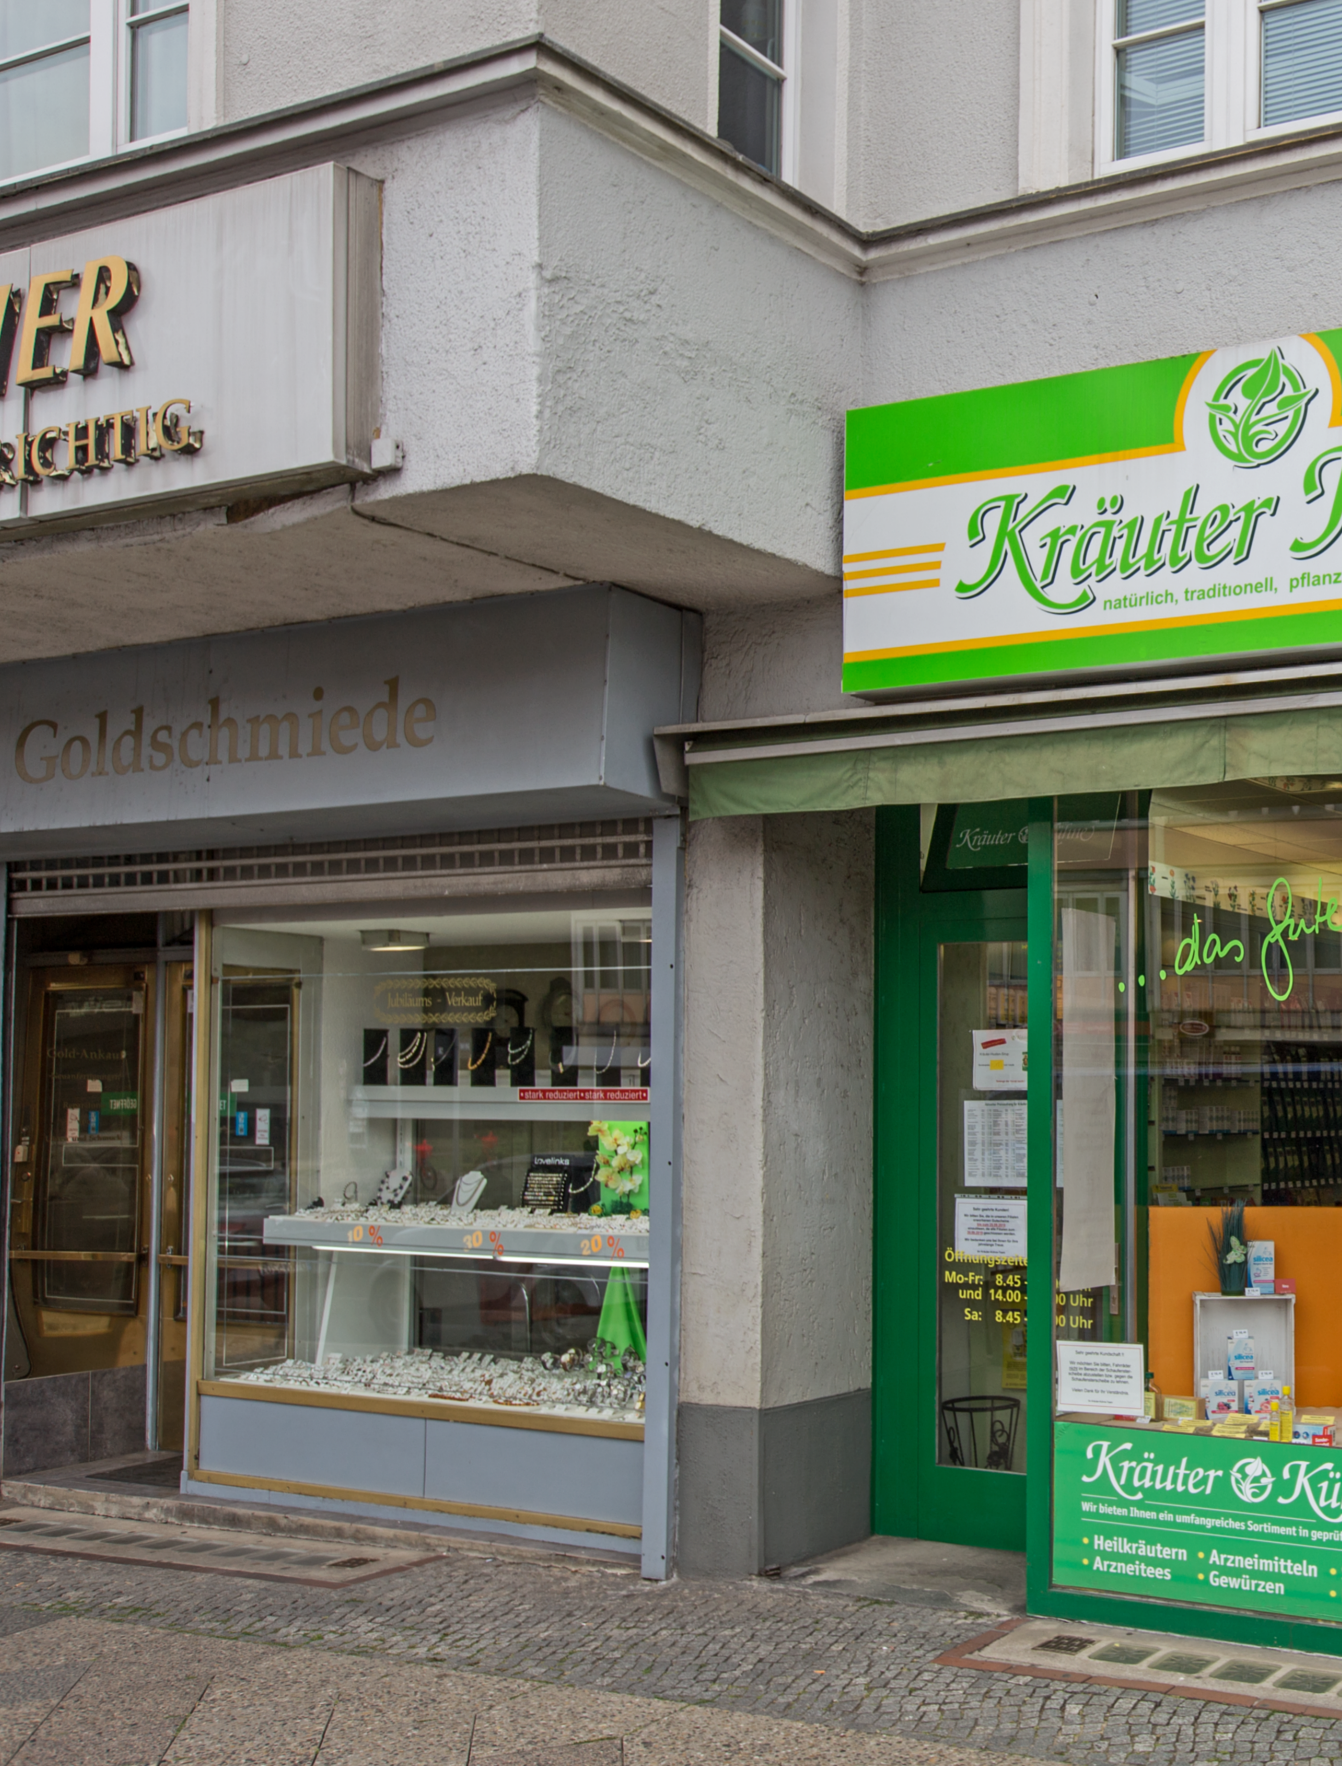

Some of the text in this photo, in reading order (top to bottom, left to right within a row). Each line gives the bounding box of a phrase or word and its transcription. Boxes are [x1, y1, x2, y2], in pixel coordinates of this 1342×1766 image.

[0, 398, 204, 487] ICHTIG
[955, 484, 1280, 615] Kräuter
[1102, 586, 1179, 612] natürlich,
[1184, 576, 1279, 603] traditionell,
[14, 675, 437, 785] Goldschmiede
[956, 828, 1016, 851] Kräuter
[446, 991, 483, 1007] Verkauf
[47, 1049, 126, 1060] Gold-Ankau
[524, 1089, 642, 1099] stark reduziert stark reduziert
[534, 1156, 570, 1166] Lovelinks
[347, 1225, 383, 1247] 10 %
[463, 1230, 504, 1256] 30 %
[580, 1234, 624, 1260] 20 %
[944, 1247, 1028, 1267] Öffnungszeite
[944, 1271, 1021, 1287] Mo-Fr: 8.45
[959, 1287, 1093, 1308] und 14.00 Uhr
[964, 1308, 1093, 1329] Sa: 8.45 Uhr
[1081, 1440, 1223, 1500] Kräuter
[1081, 1501, 1097, 1513] Wir
[1099, 1503, 1128, 1517] bieten
[1129, 1506, 1157, 1520] Ihnen
[1159, 1510, 1174, 1522] ein
[1176, 1511, 1245, 1532] umfangreiches
[1247, 1519, 1297, 1537] Sortiment
[1299, 1525, 1308, 1537] in
[1094, 1535, 1187, 1561] Heilkräutern
[1093, 1557, 1172, 1581] Arzneitees
[1209, 1549, 1318, 1578] Arzneimitteln
[1209, 1571, 1285, 1596] Gewürzen
